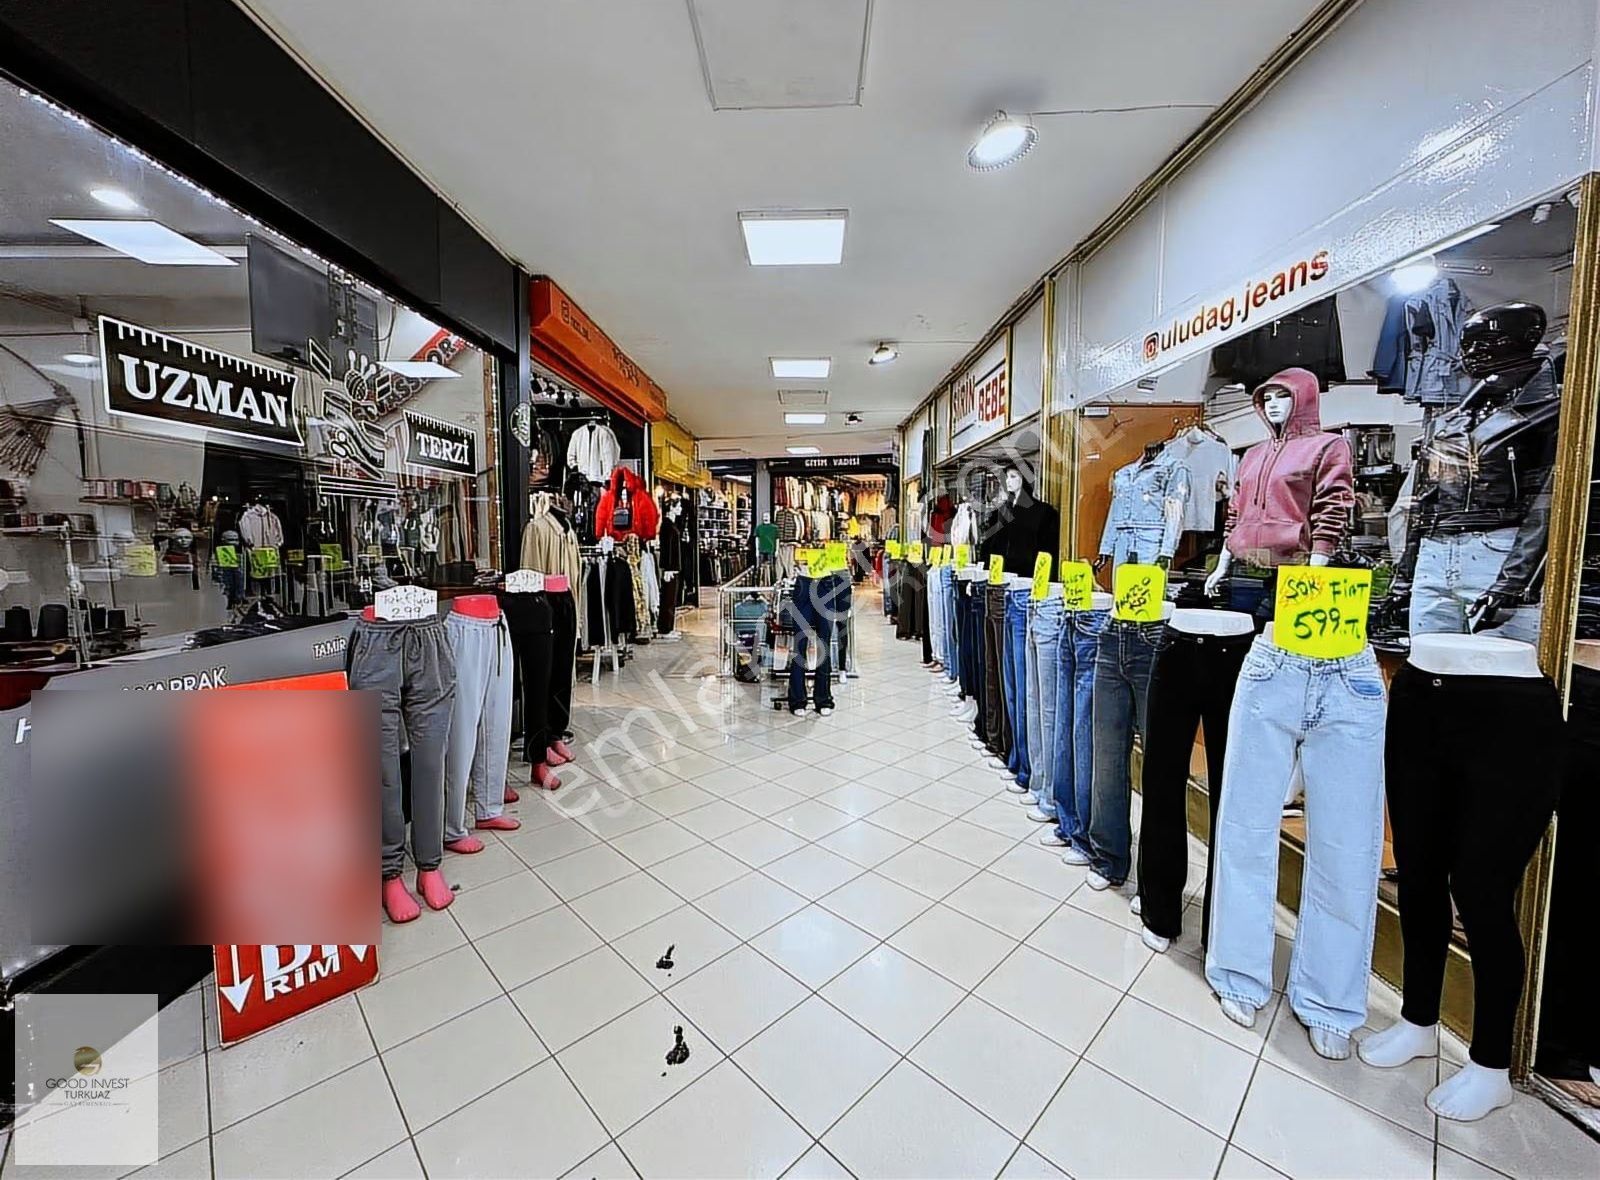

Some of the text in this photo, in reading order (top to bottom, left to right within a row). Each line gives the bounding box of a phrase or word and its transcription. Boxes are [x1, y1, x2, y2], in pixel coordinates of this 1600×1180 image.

[1161, 250, 1329, 351] uludag.jeans
[118, 353, 288, 428] UZMAN
[415, 432, 470, 465] TERZİ
